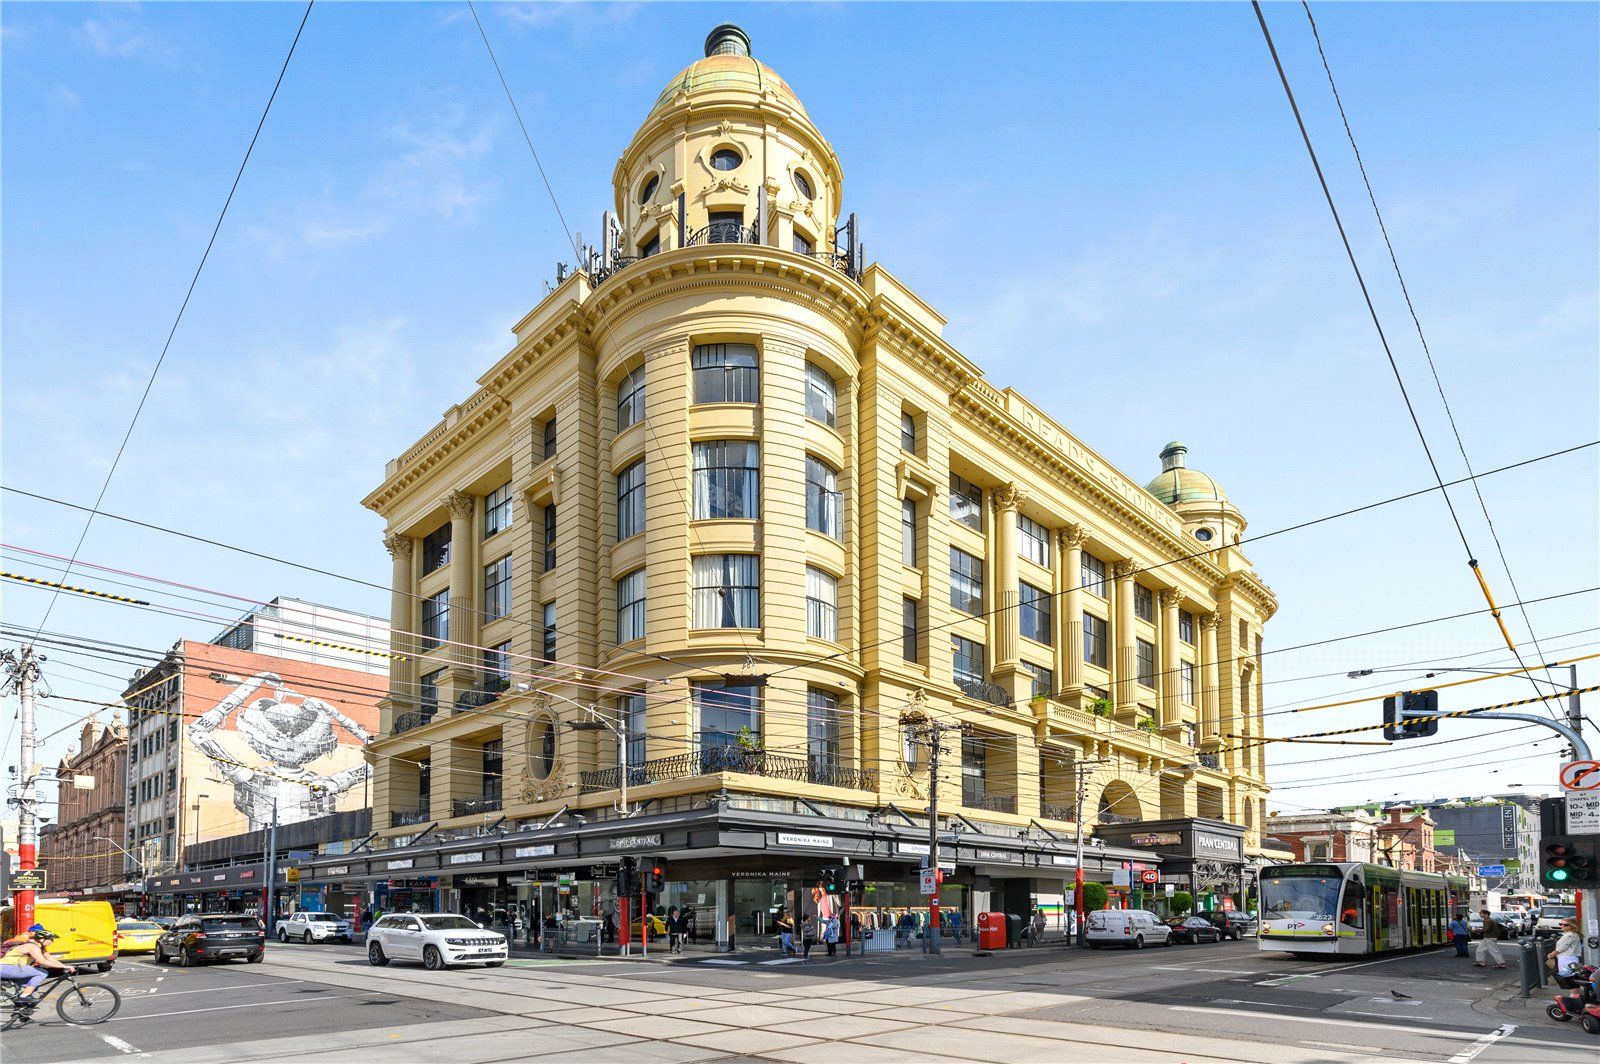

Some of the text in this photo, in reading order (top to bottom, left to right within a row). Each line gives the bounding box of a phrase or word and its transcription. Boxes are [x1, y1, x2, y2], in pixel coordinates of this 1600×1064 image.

[1110, 475, 1174, 531] STORES
[1198, 836, 1237, 851] PRAN CENTRAL
